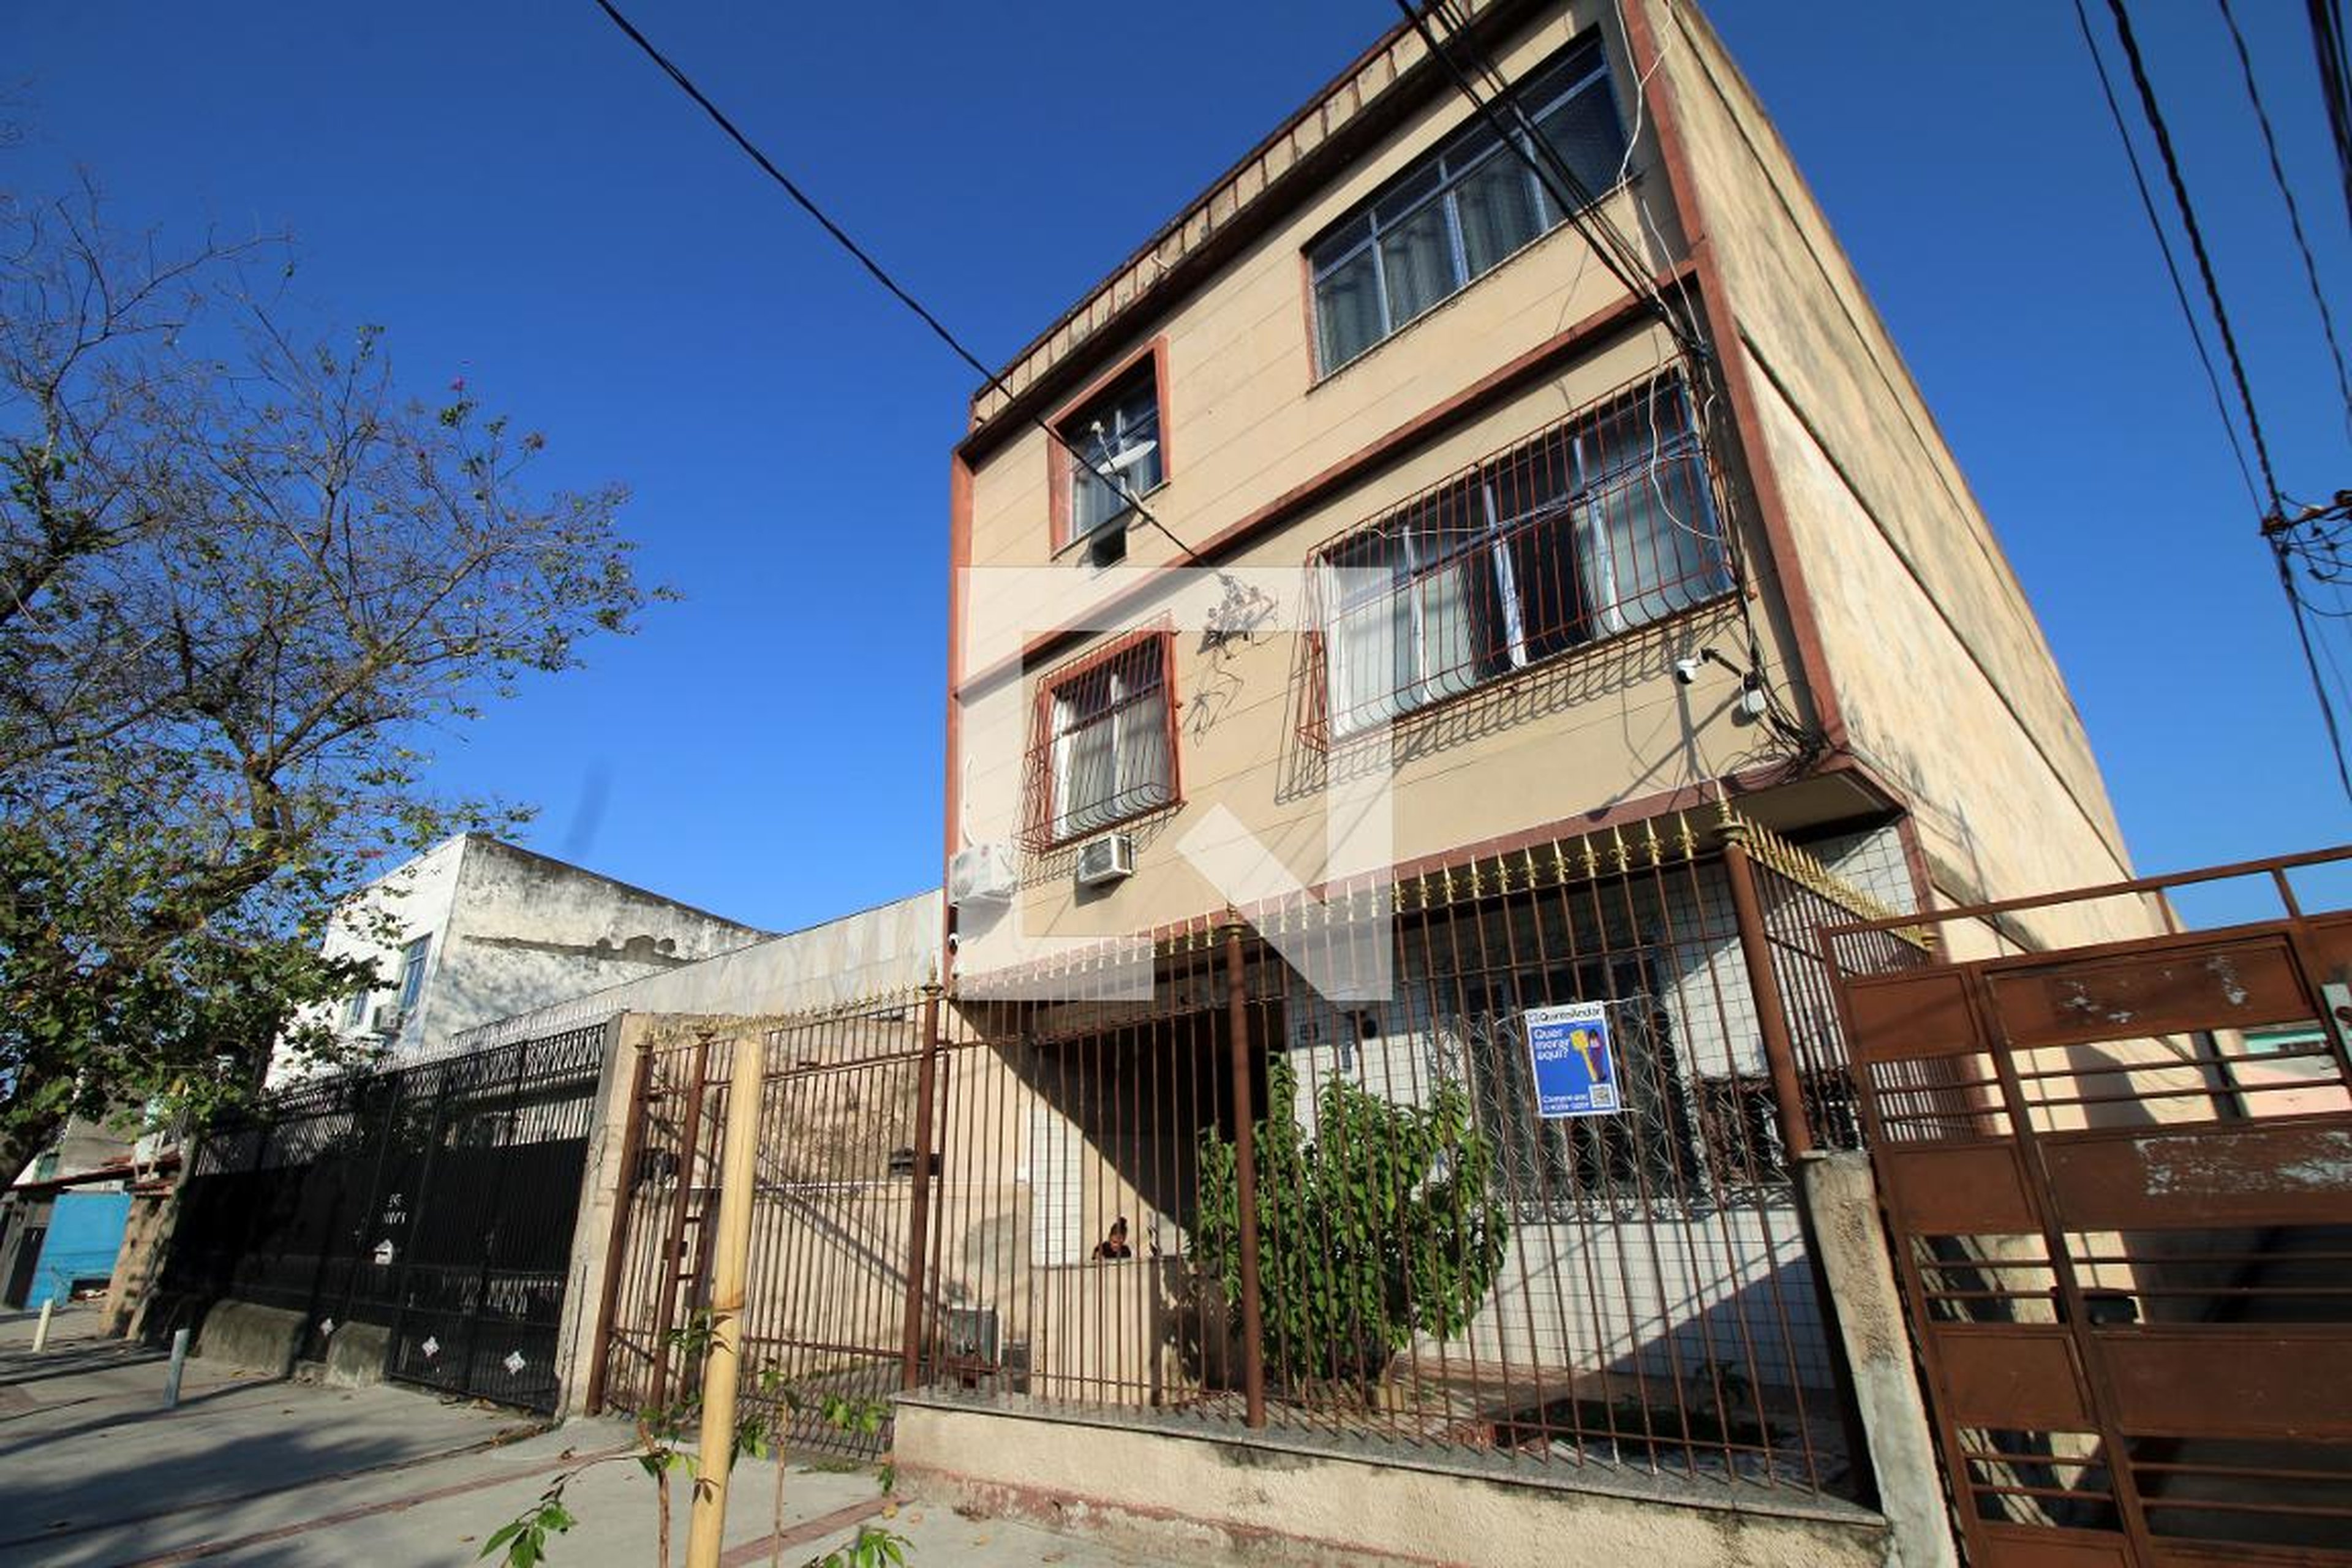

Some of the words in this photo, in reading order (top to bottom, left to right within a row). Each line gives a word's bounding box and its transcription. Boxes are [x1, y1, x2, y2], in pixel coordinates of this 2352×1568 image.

[1533, 1029, 1563, 1039] Quer
[1535, 1039, 1569, 1049] morar
[1537, 1047, 1569, 1061] aqui?
